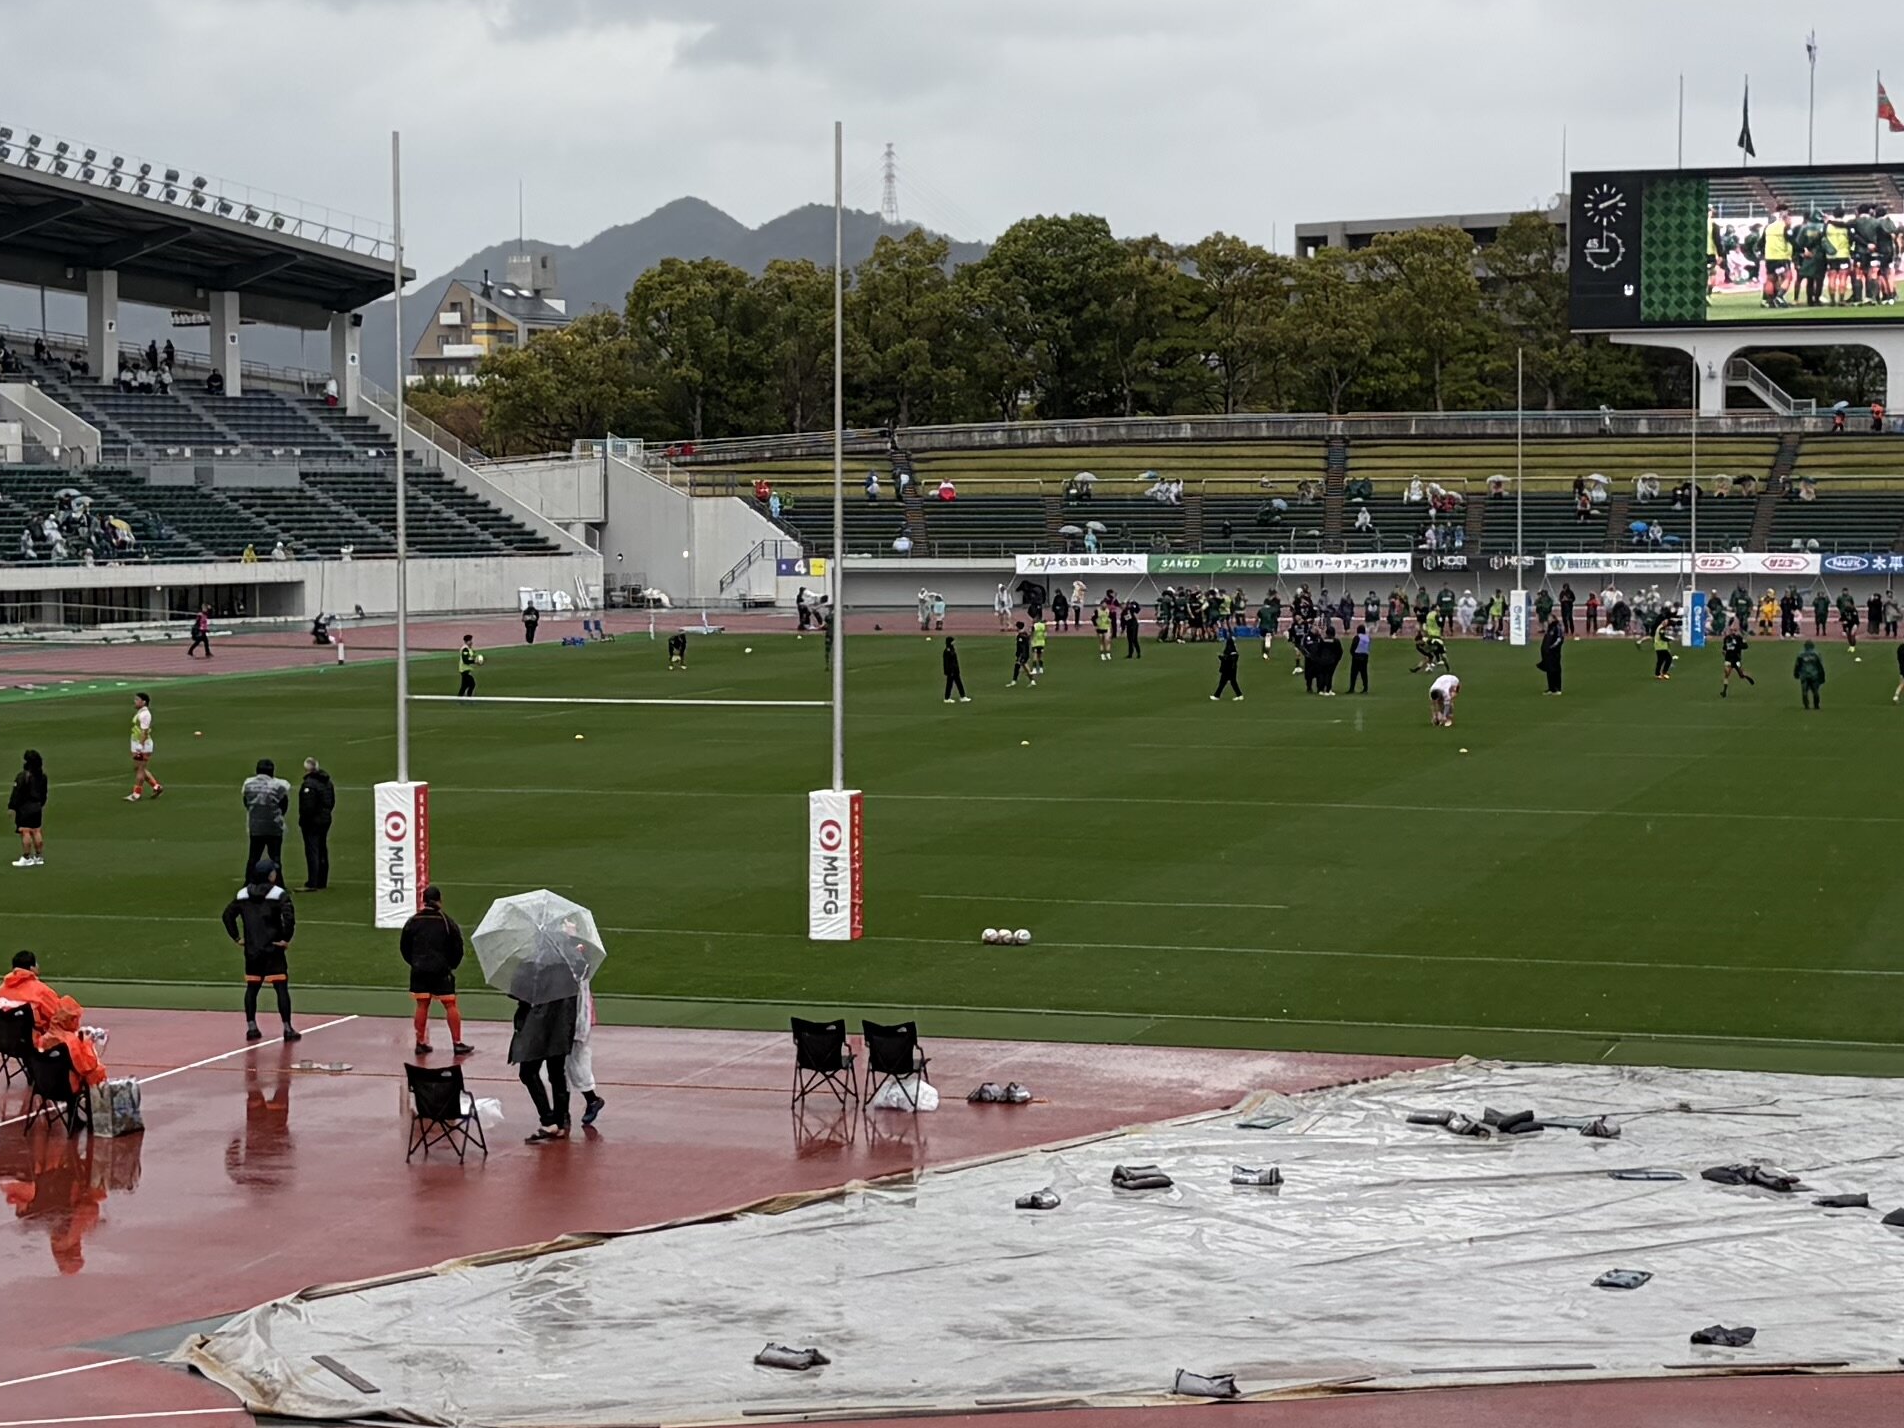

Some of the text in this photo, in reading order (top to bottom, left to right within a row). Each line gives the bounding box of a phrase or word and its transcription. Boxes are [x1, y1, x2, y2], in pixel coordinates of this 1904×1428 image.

[794, 560, 807, 575] 4
[1161, 559, 1200, 568] SANGO
[1225, 558, 1264, 568] SANGO
[389, 846, 404, 903] MUFG
[823, 856, 838, 914] MUFG
